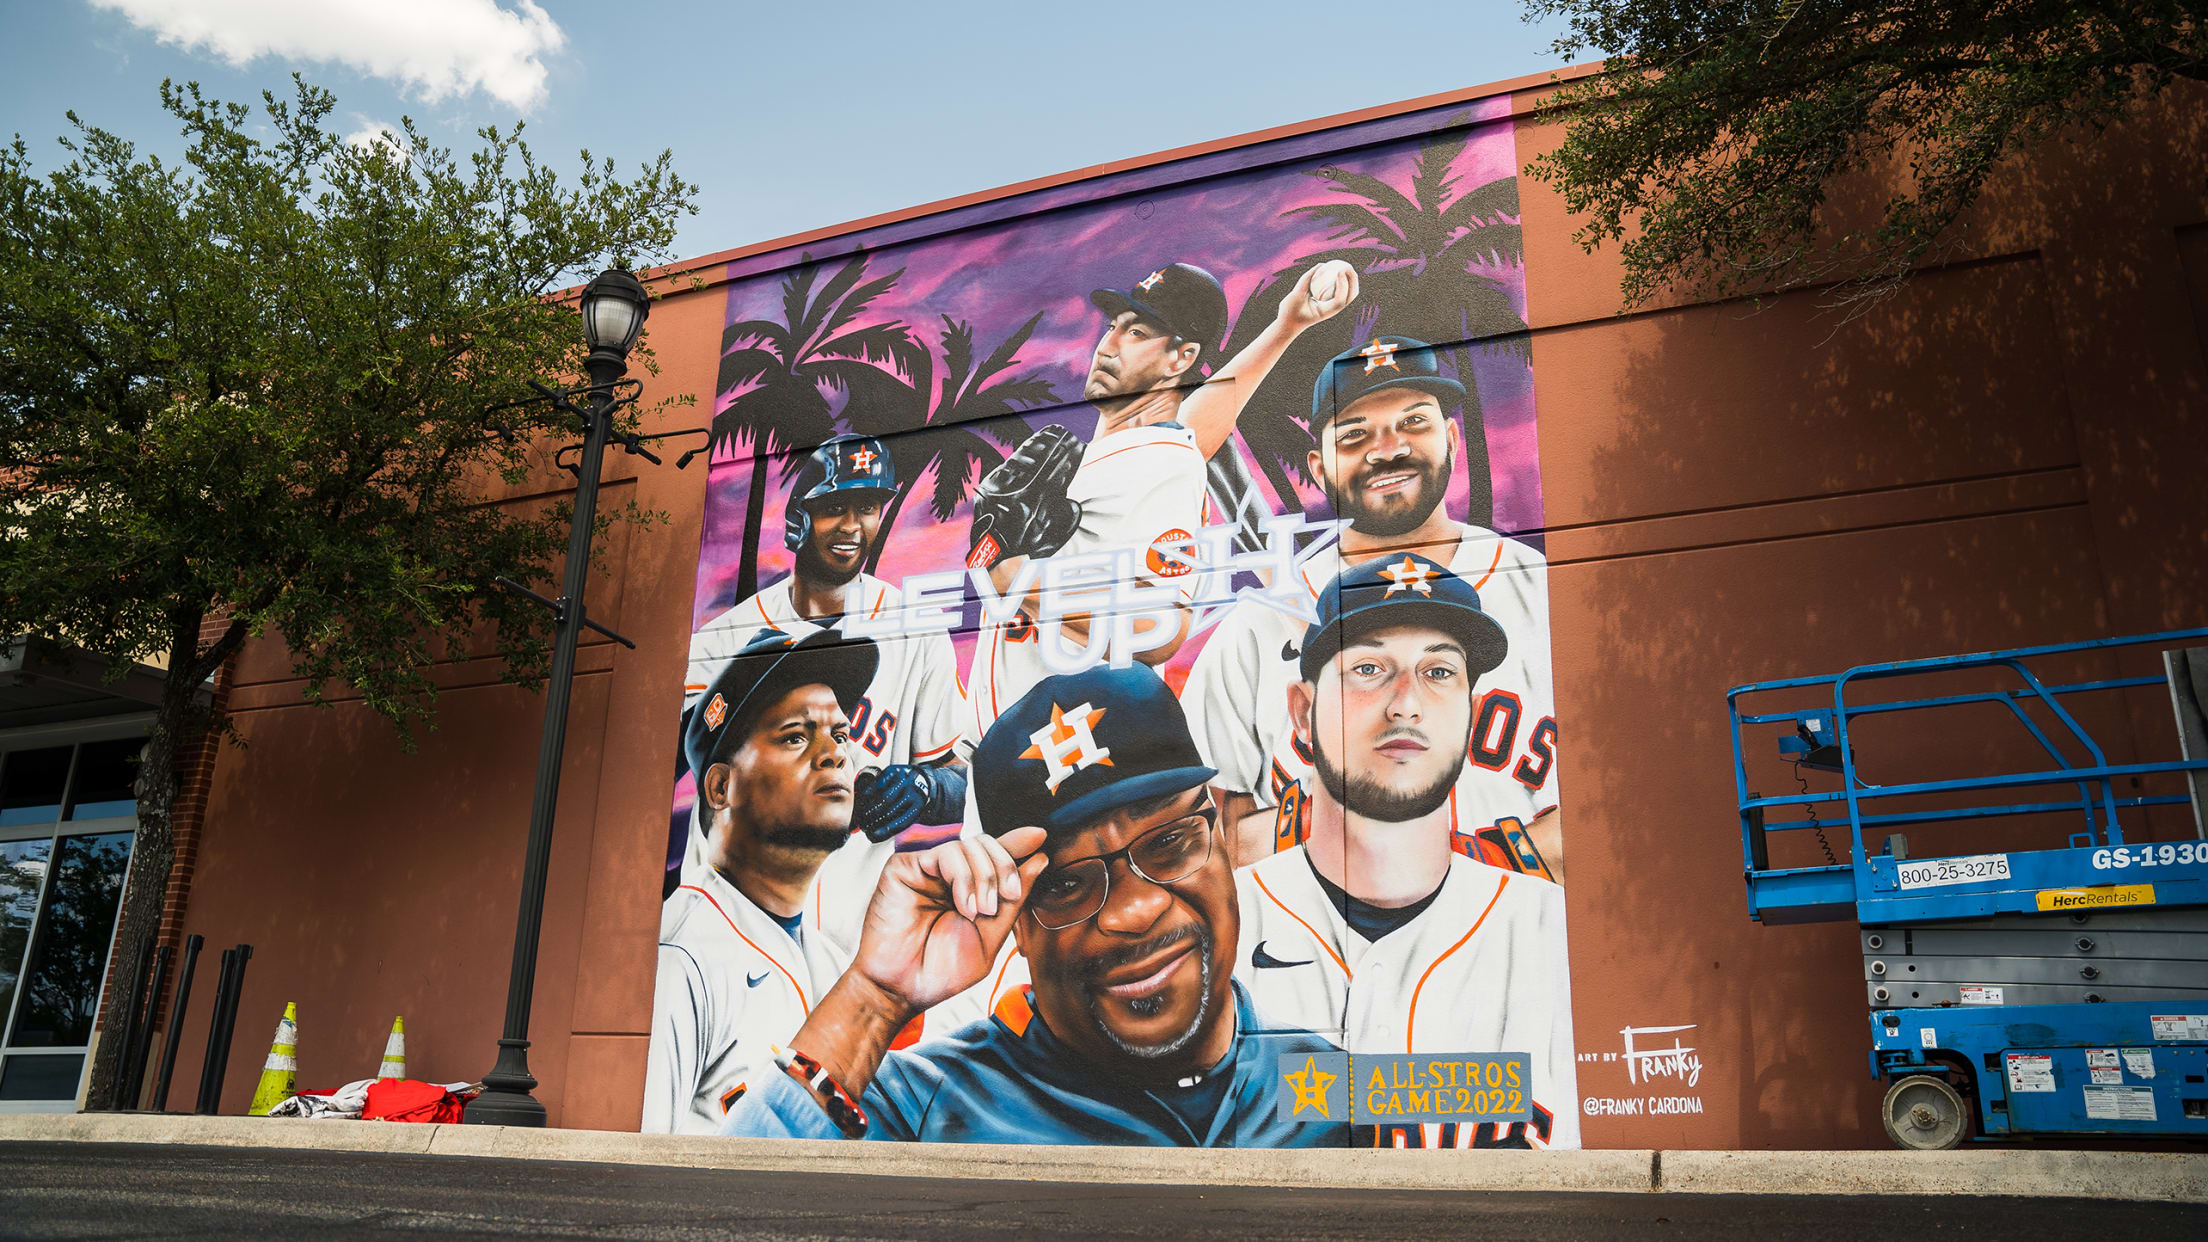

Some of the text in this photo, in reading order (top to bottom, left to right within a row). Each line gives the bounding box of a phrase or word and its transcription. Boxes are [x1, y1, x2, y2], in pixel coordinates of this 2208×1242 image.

[1159, 565, 1190, 576] ASTRO
[841, 547, 1181, 640] LEVEL
[1037, 602, 1181, 675] UP
[2092, 843, 2208, 870] GS-1930
[1901, 861, 2007, 884] 800-25-3275
[1577, 1053, 1598, 1062] ART
[1603, 1053, 1617, 1062] BY
[1366, 1061, 1521, 1089] ALL-STROS
